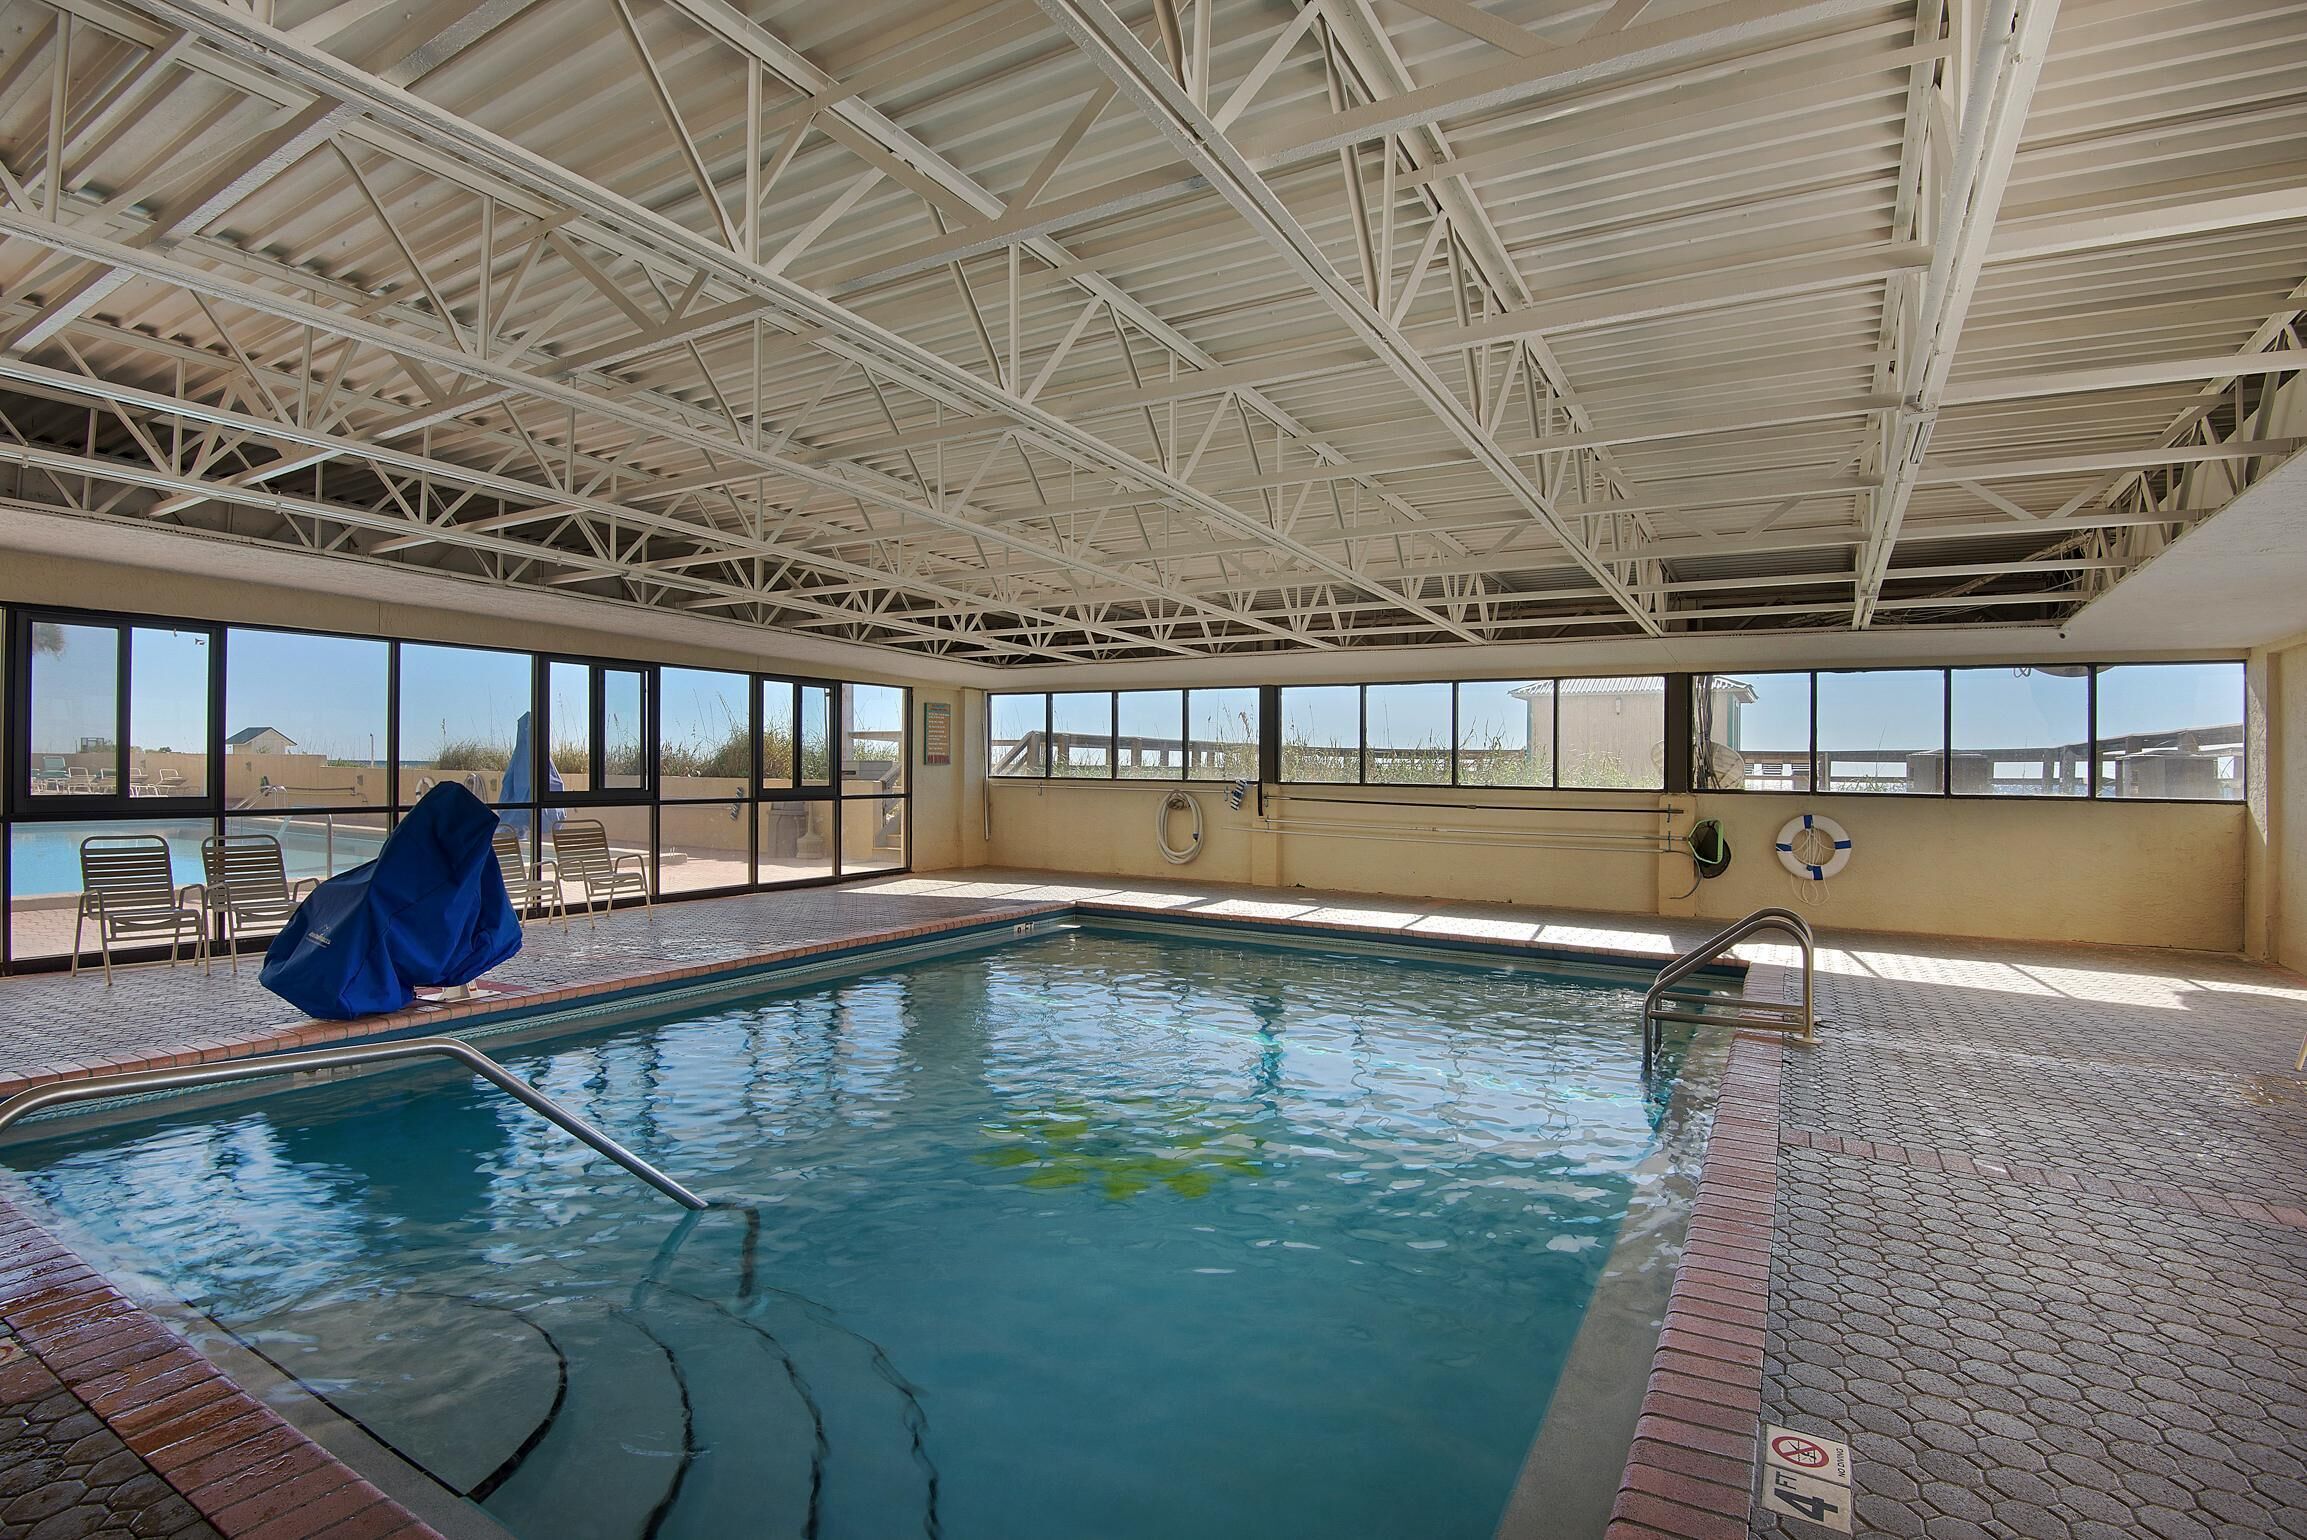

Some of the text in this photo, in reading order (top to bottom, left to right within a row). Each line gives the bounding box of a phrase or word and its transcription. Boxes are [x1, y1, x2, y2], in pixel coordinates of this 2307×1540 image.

[1835, 1447, 1846, 1478] NO DIVING
[1774, 1471, 1839, 1523] 4 FT
